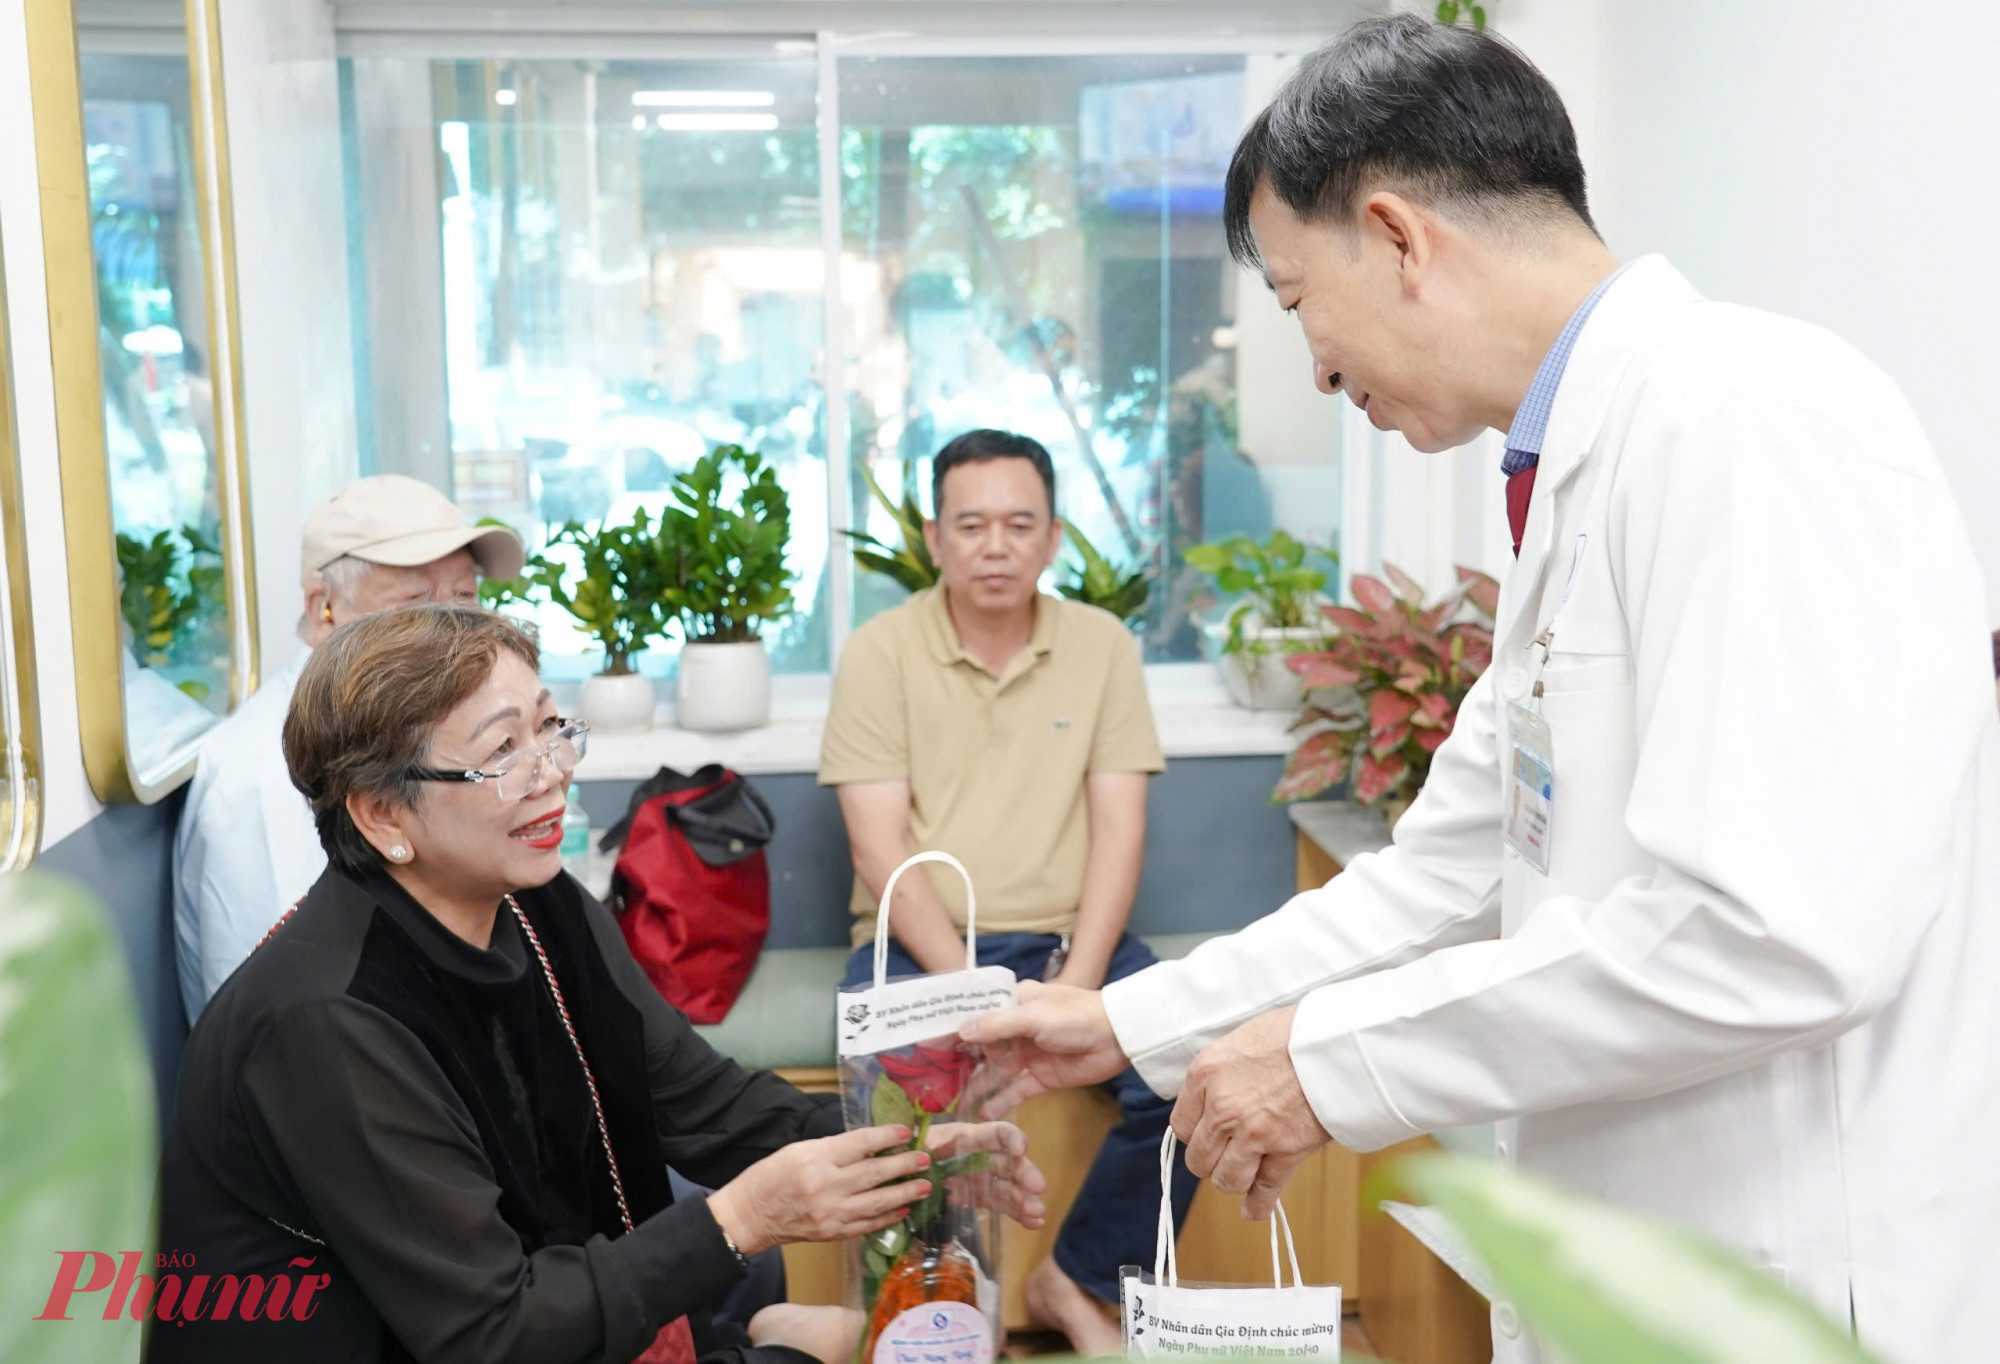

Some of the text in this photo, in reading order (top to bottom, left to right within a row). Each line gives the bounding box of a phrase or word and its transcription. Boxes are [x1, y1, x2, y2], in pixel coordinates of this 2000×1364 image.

[1161, 1318, 1188, 1334] Nhân
[1190, 1323, 1213, 1336] dân
[1215, 1325, 1235, 1338] Gia
[1238, 1325, 1268, 1340] Định
[1270, 1324, 1300, 1338] chúc
[1302, 1322, 1334, 1336] mừng
[1158, 1337, 1319, 1359] Ngày Phụ nữ Việt Nam 20/10
